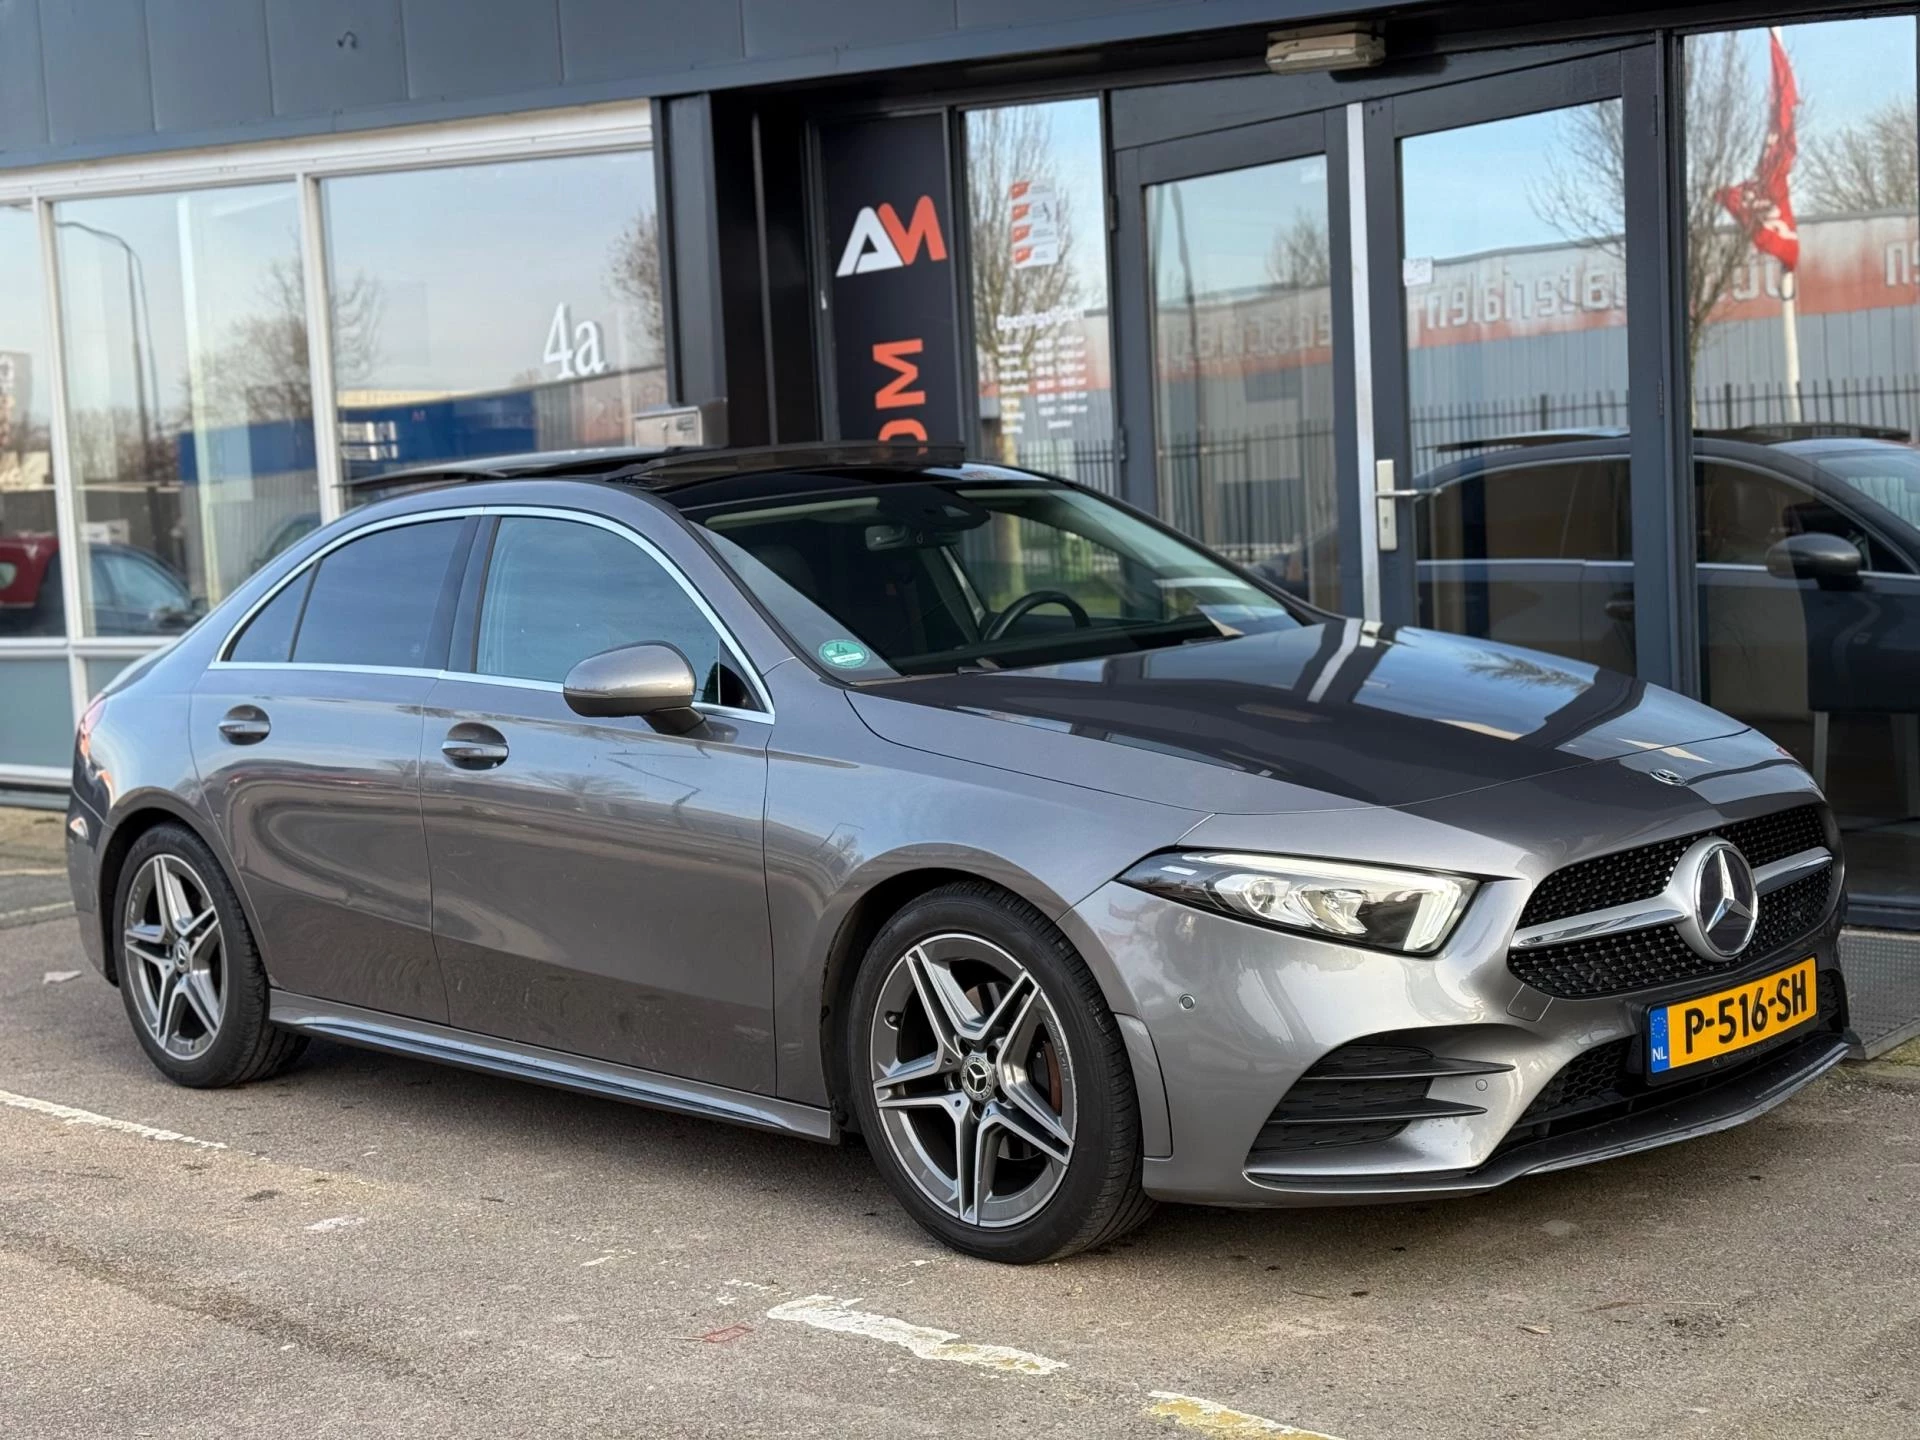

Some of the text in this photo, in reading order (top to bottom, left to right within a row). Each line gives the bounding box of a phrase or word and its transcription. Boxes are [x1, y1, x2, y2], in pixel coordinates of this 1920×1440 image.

[543, 302, 605, 380] 4a
[1685, 970, 1807, 1055] P-516-SH
[1652, 1046, 1668, 1063] NL
